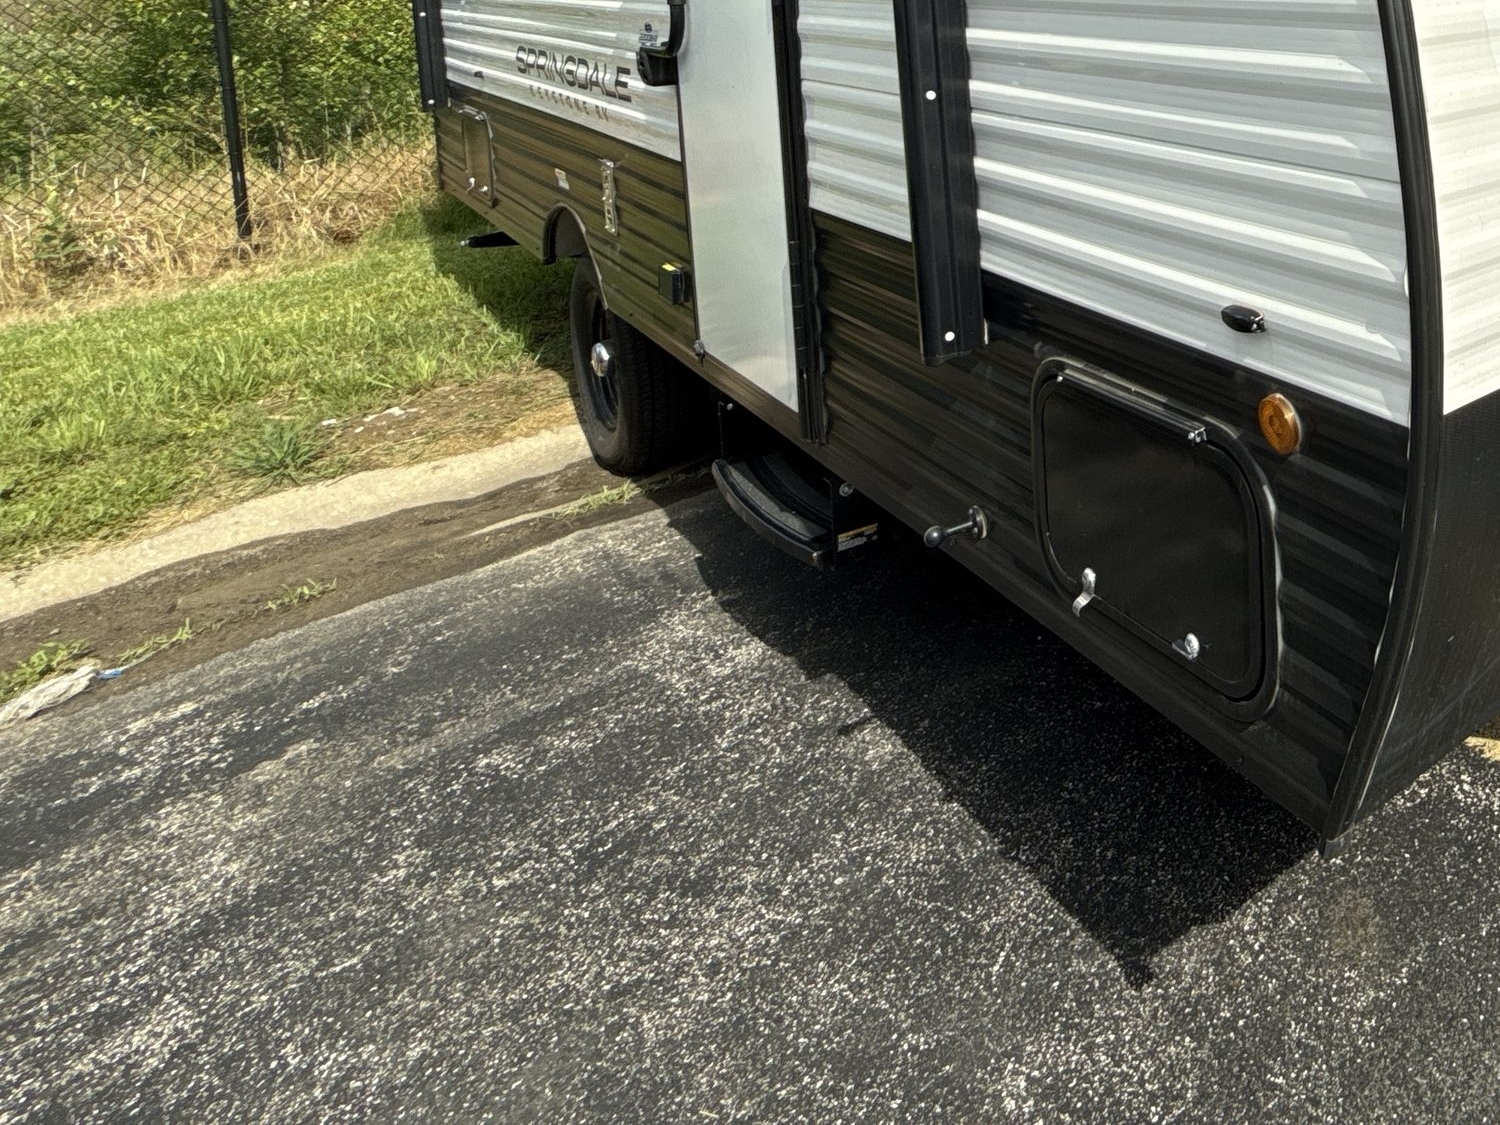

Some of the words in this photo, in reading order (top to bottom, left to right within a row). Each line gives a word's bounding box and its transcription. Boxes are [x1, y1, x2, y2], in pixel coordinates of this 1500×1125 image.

[516, 45, 632, 103] SPRINGDALE
[530, 85, 590, 115] KEYSTONE
[595, 105, 609, 122] RV
